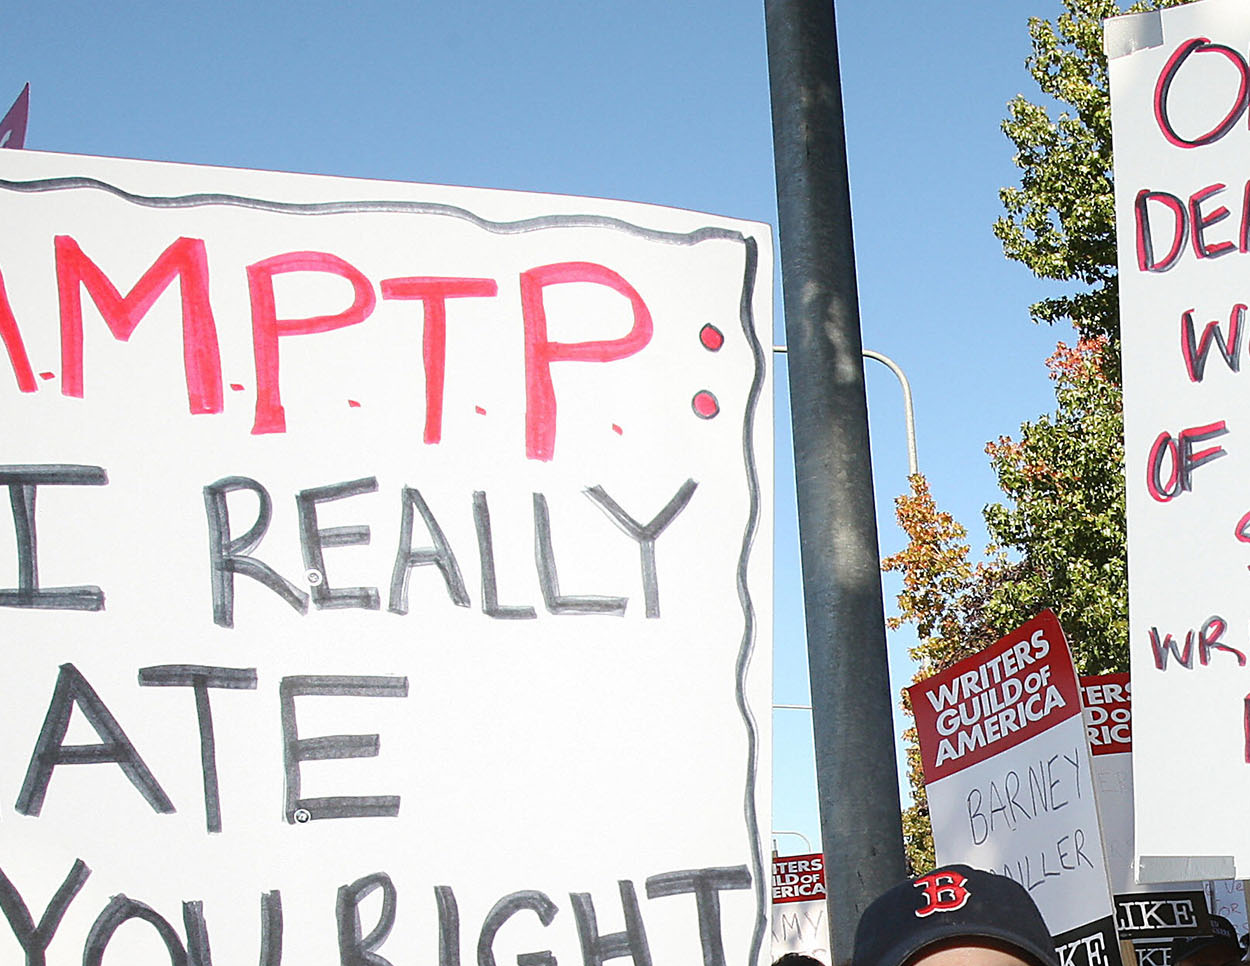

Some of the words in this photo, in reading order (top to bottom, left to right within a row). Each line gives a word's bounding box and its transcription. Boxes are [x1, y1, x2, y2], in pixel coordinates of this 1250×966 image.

[1146, 419, 1229, 503] OF
[203, 475, 698, 630] REALLY
[926, 629, 1050, 713] WRITERS
[936, 677, 1022, 737] GUILD
[1023, 664, 1051, 694] OF
[15, 662, 409, 834] ATE
[935, 684, 1066, 768] AMERICA
[967, 747, 1082, 846] BARNEY
[800, 873, 820, 884] OF
